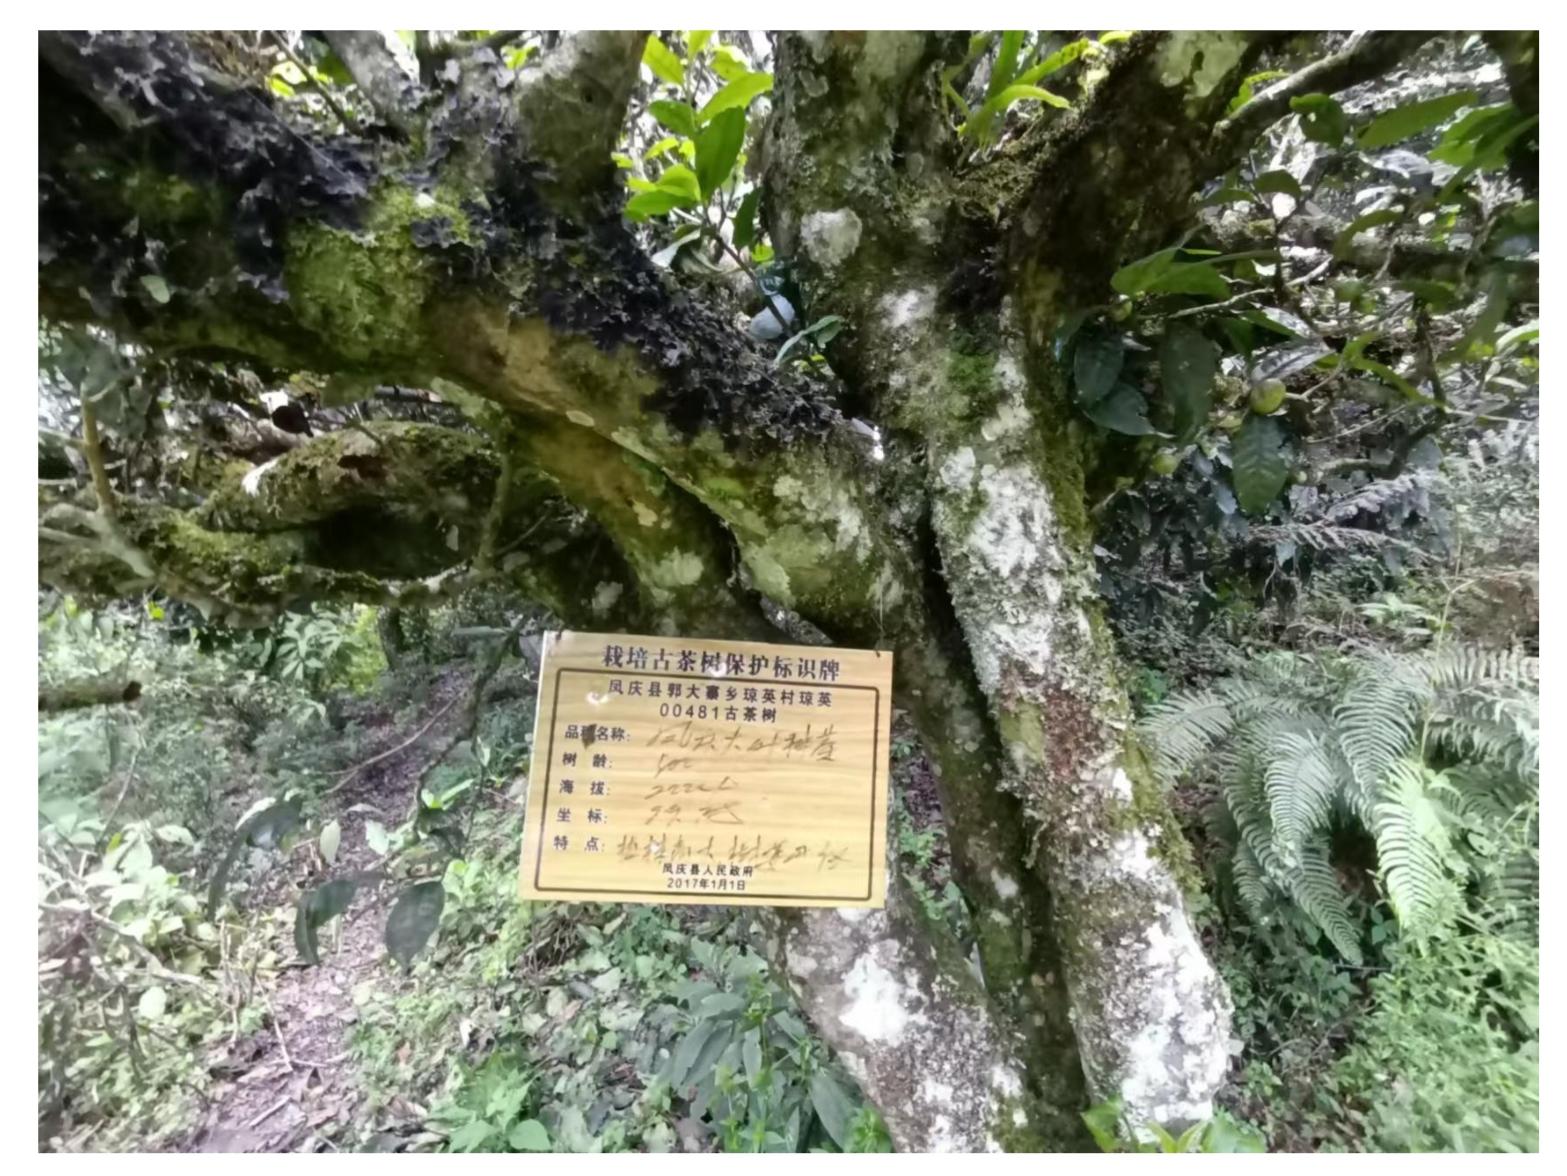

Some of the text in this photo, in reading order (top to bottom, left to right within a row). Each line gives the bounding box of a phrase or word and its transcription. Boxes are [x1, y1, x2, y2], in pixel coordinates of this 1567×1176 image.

[600, 644, 841, 681] 栽培古茶树保护标识牌
[608, 679, 833, 707] 凤庆县郭大寨乡琼英村琼英
[659, 703, 777, 722] 00481古茶树
[662, 862, 754, 877] 凤庆县人民政府
[666, 877, 747, 891] 2017年1月1日
